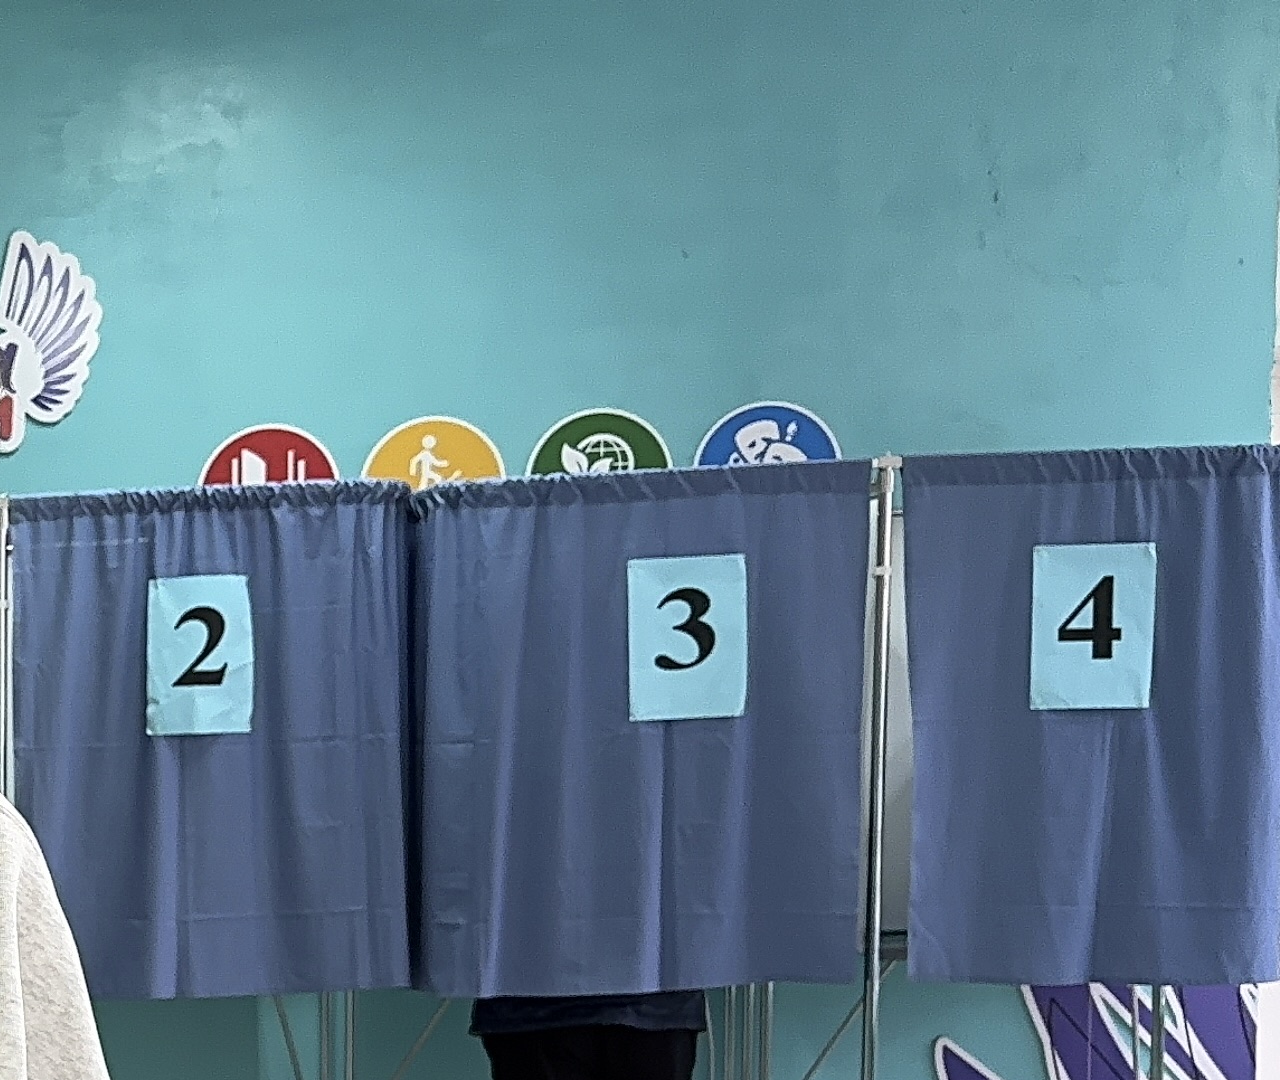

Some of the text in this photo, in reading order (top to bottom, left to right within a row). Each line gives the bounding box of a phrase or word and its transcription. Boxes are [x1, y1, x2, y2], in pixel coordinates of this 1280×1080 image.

[173, 607, 227, 687] 2
[655, 588, 715, 670] 3
[1058, 576, 1121, 659] 4
